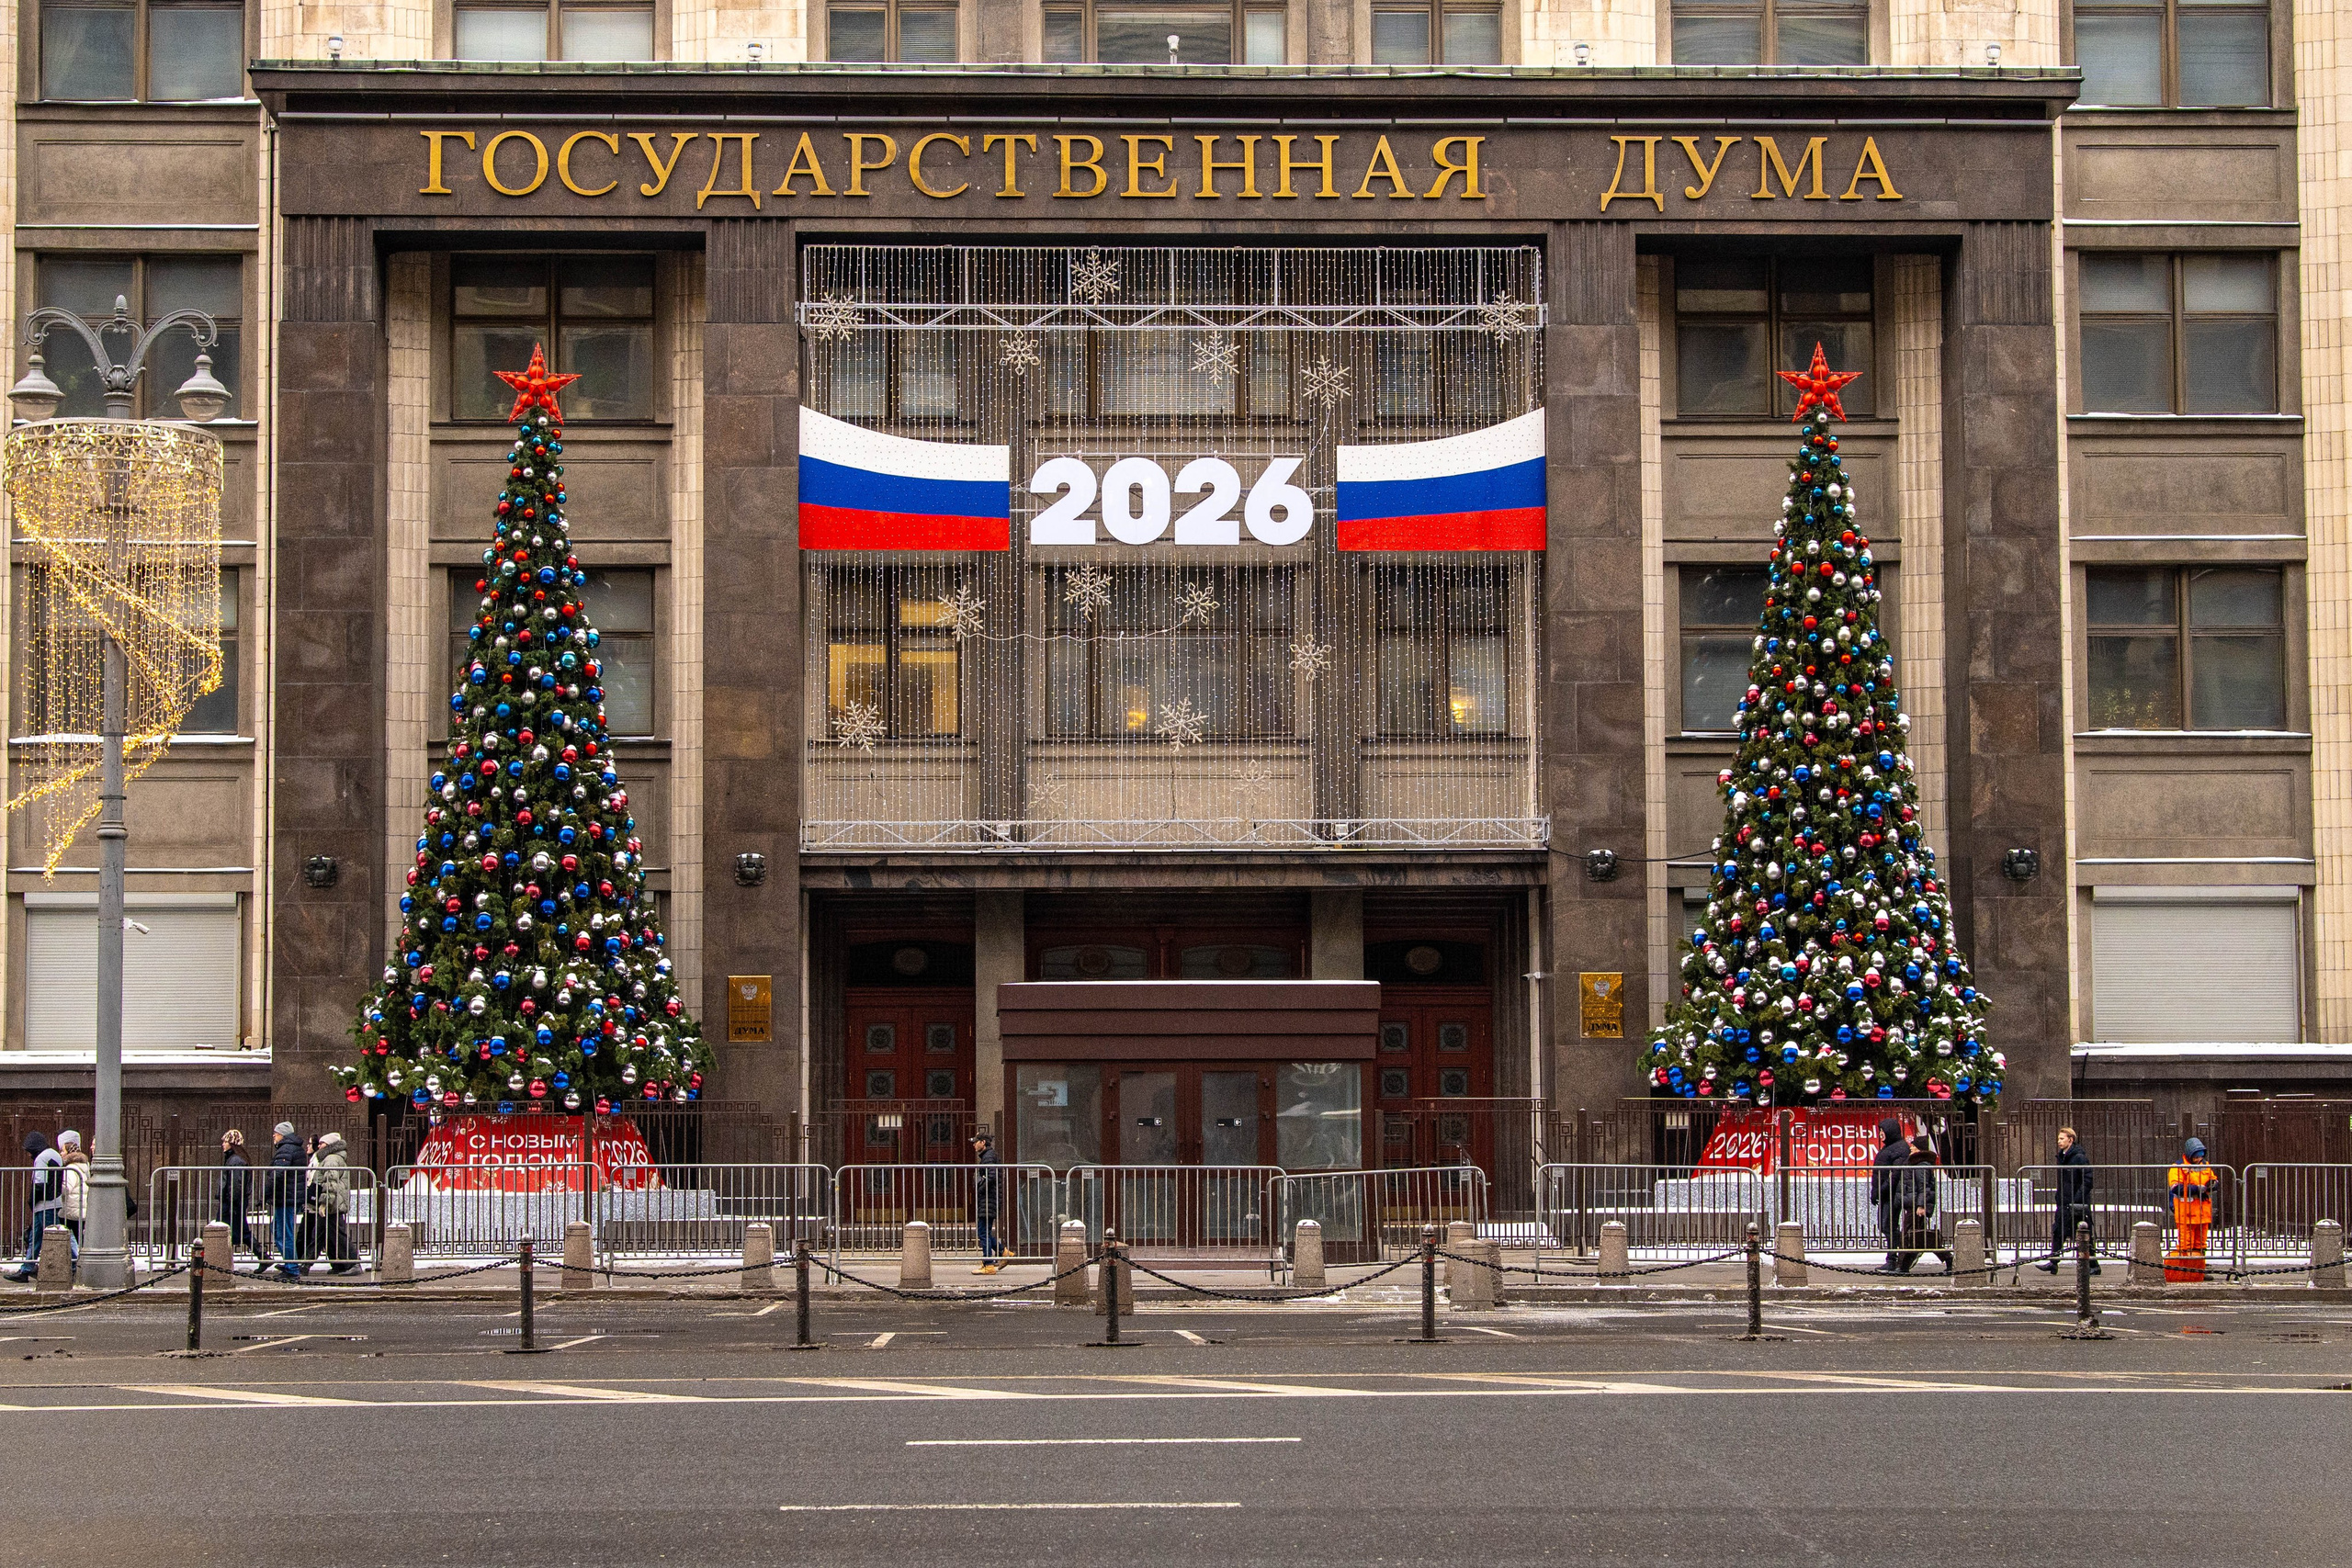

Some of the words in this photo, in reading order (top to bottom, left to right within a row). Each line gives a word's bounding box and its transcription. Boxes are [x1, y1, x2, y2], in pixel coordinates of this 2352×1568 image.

[418, 130, 1487, 210] ГОСУДАРСТВЕННАЯ
[1600, 135, 1904, 212] ДУМА
[1030, 457, 1314, 546] 2026
[734, 1026, 764, 1035] ДУМА
[469, 1134, 485, 1148] С
[492, 1134, 578, 1148] НОВЫМ
[1814, 1124, 1878, 1138] НОВЫ
[602, 1140, 648, 1167] 2026
[1709, 1132, 1768, 1159] 2026
